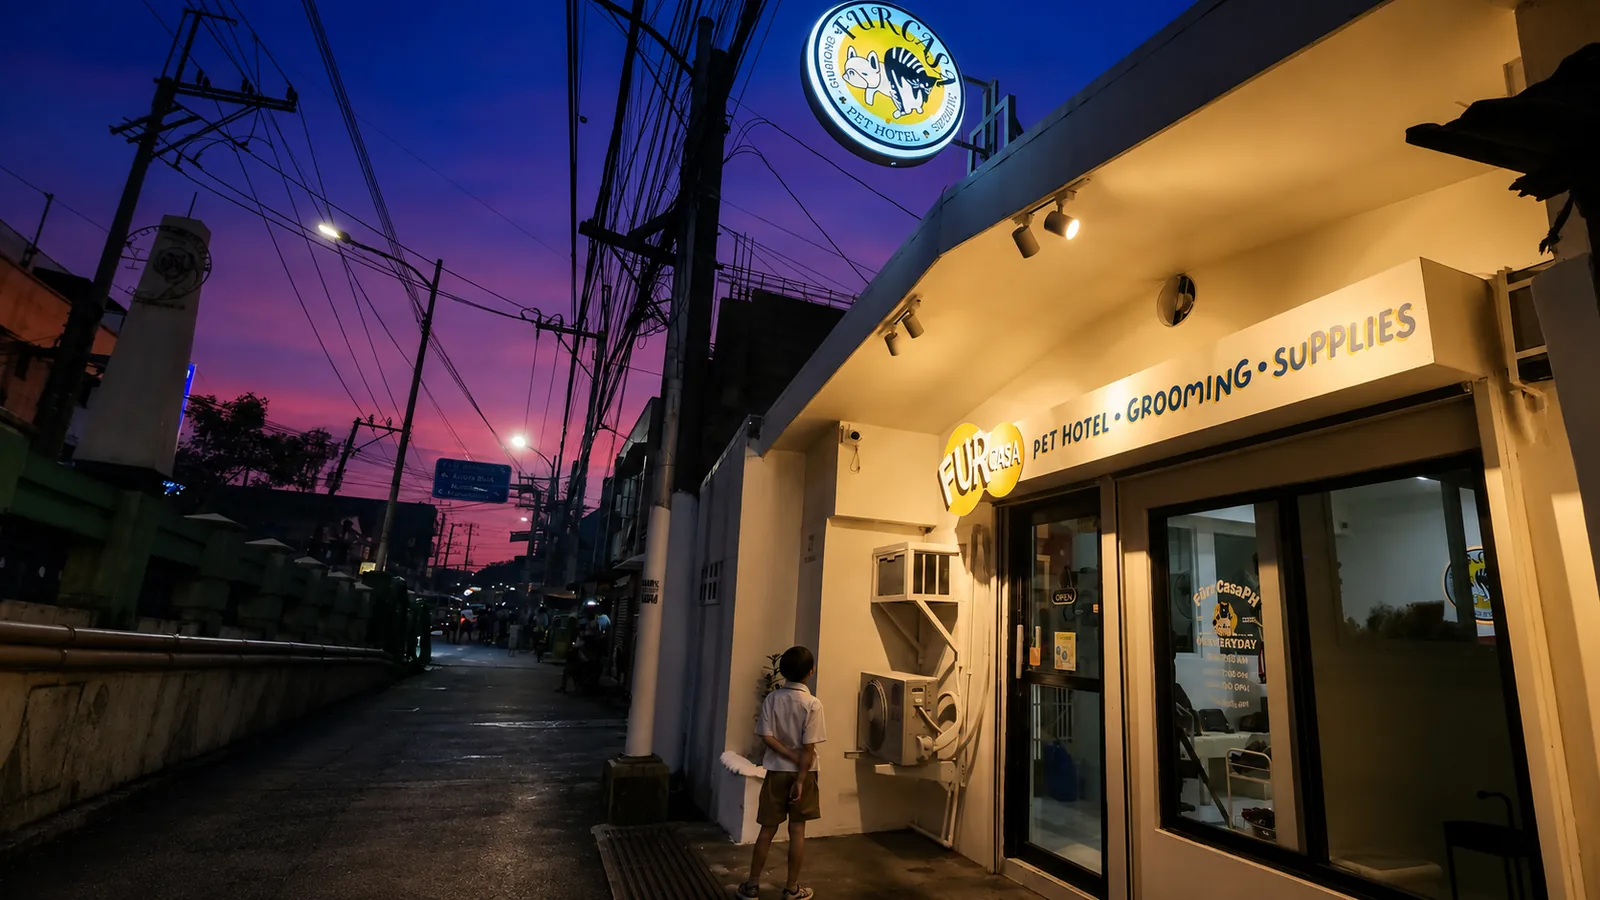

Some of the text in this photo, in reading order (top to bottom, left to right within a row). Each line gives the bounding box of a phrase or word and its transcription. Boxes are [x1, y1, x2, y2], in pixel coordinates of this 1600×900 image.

[846, 106, 920, 142] PET HOTEL
[1033, 302, 1417, 460] PET HOTEL GROOMING SUPPLIES
[938, 430, 1021, 509] FUR CASA
[1055, 594, 1073, 602] OPEN
